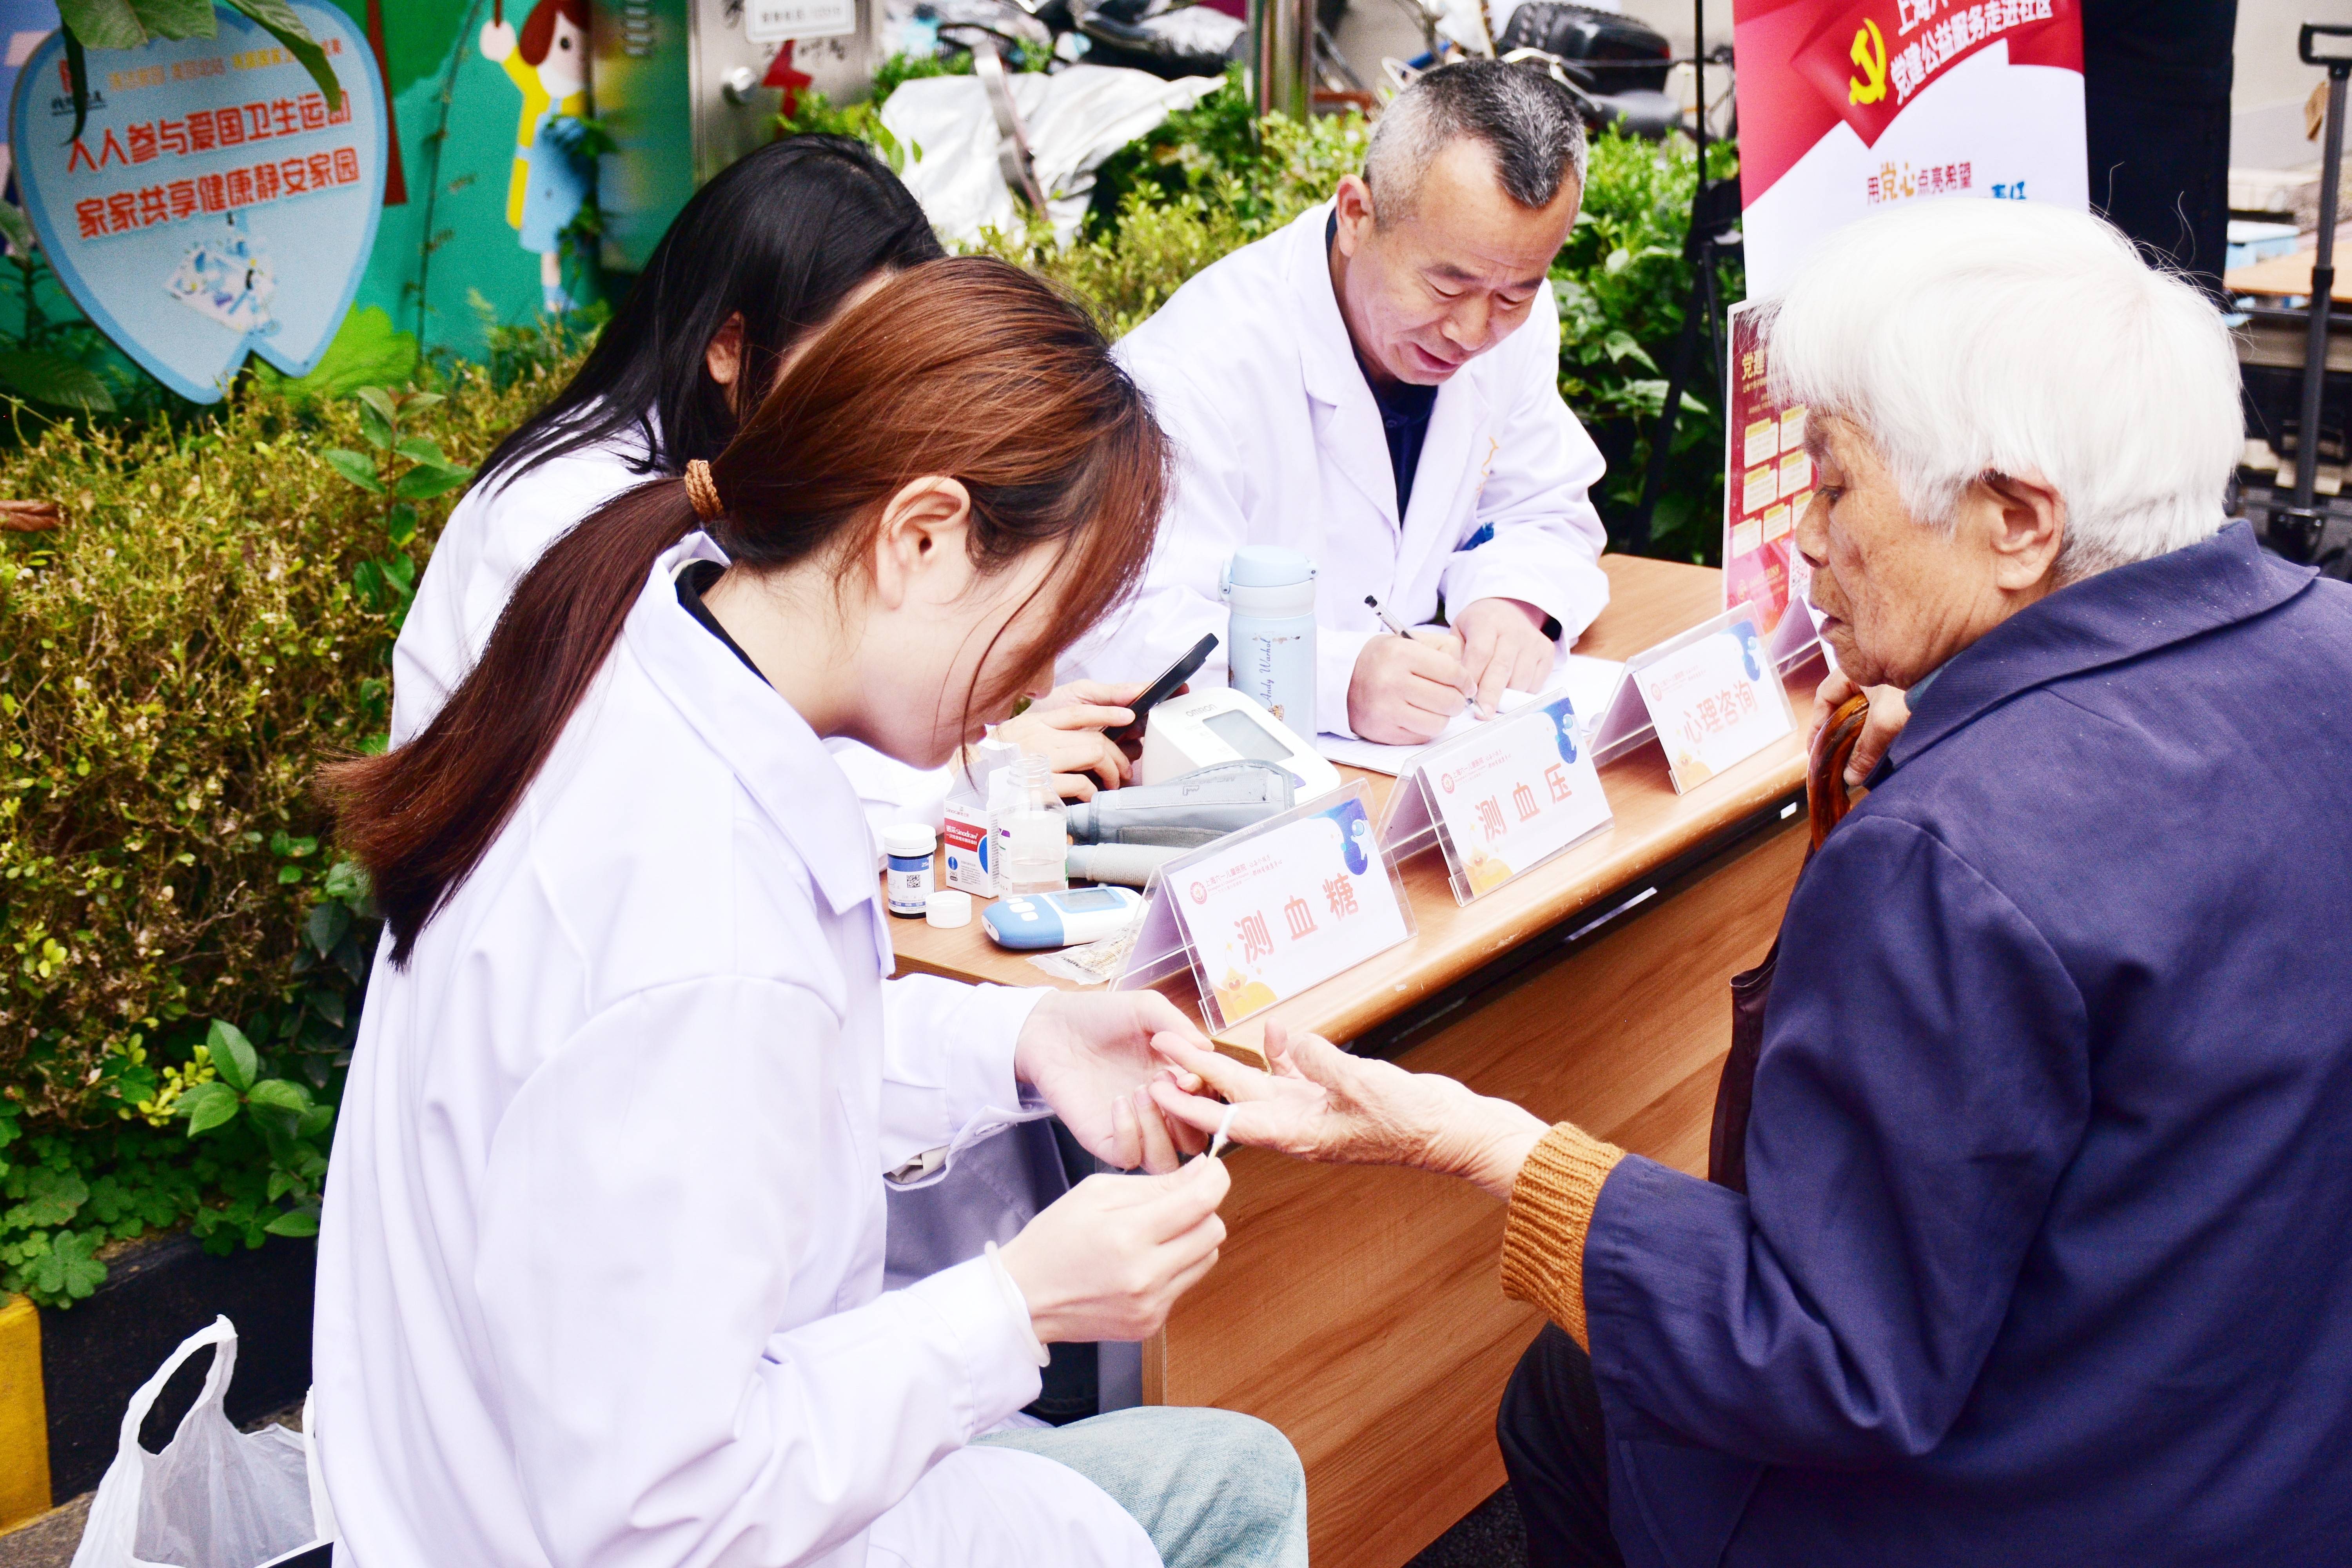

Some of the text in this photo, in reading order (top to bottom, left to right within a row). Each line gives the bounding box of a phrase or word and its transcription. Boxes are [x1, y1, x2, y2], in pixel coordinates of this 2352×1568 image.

[1890, 0, 2053, 105] 党建公益服务走进社区
[76, 147, 360, 239] 家家共享健康静安家园
[1867, 161, 1971, 206] 用党心点亮希望
[1742, 349, 1769, 381] 党建
[1259, 637, 1274, 706] Andy Warhol
[1186, 704, 1217, 717] OMRON
[1683, 680, 1758, 744] 心理咨询
[1475, 762, 1572, 843] 测血压
[1205, 863, 1247, 887] 上海六一儿童医院
[1234, 873, 1359, 964] 测血糖
